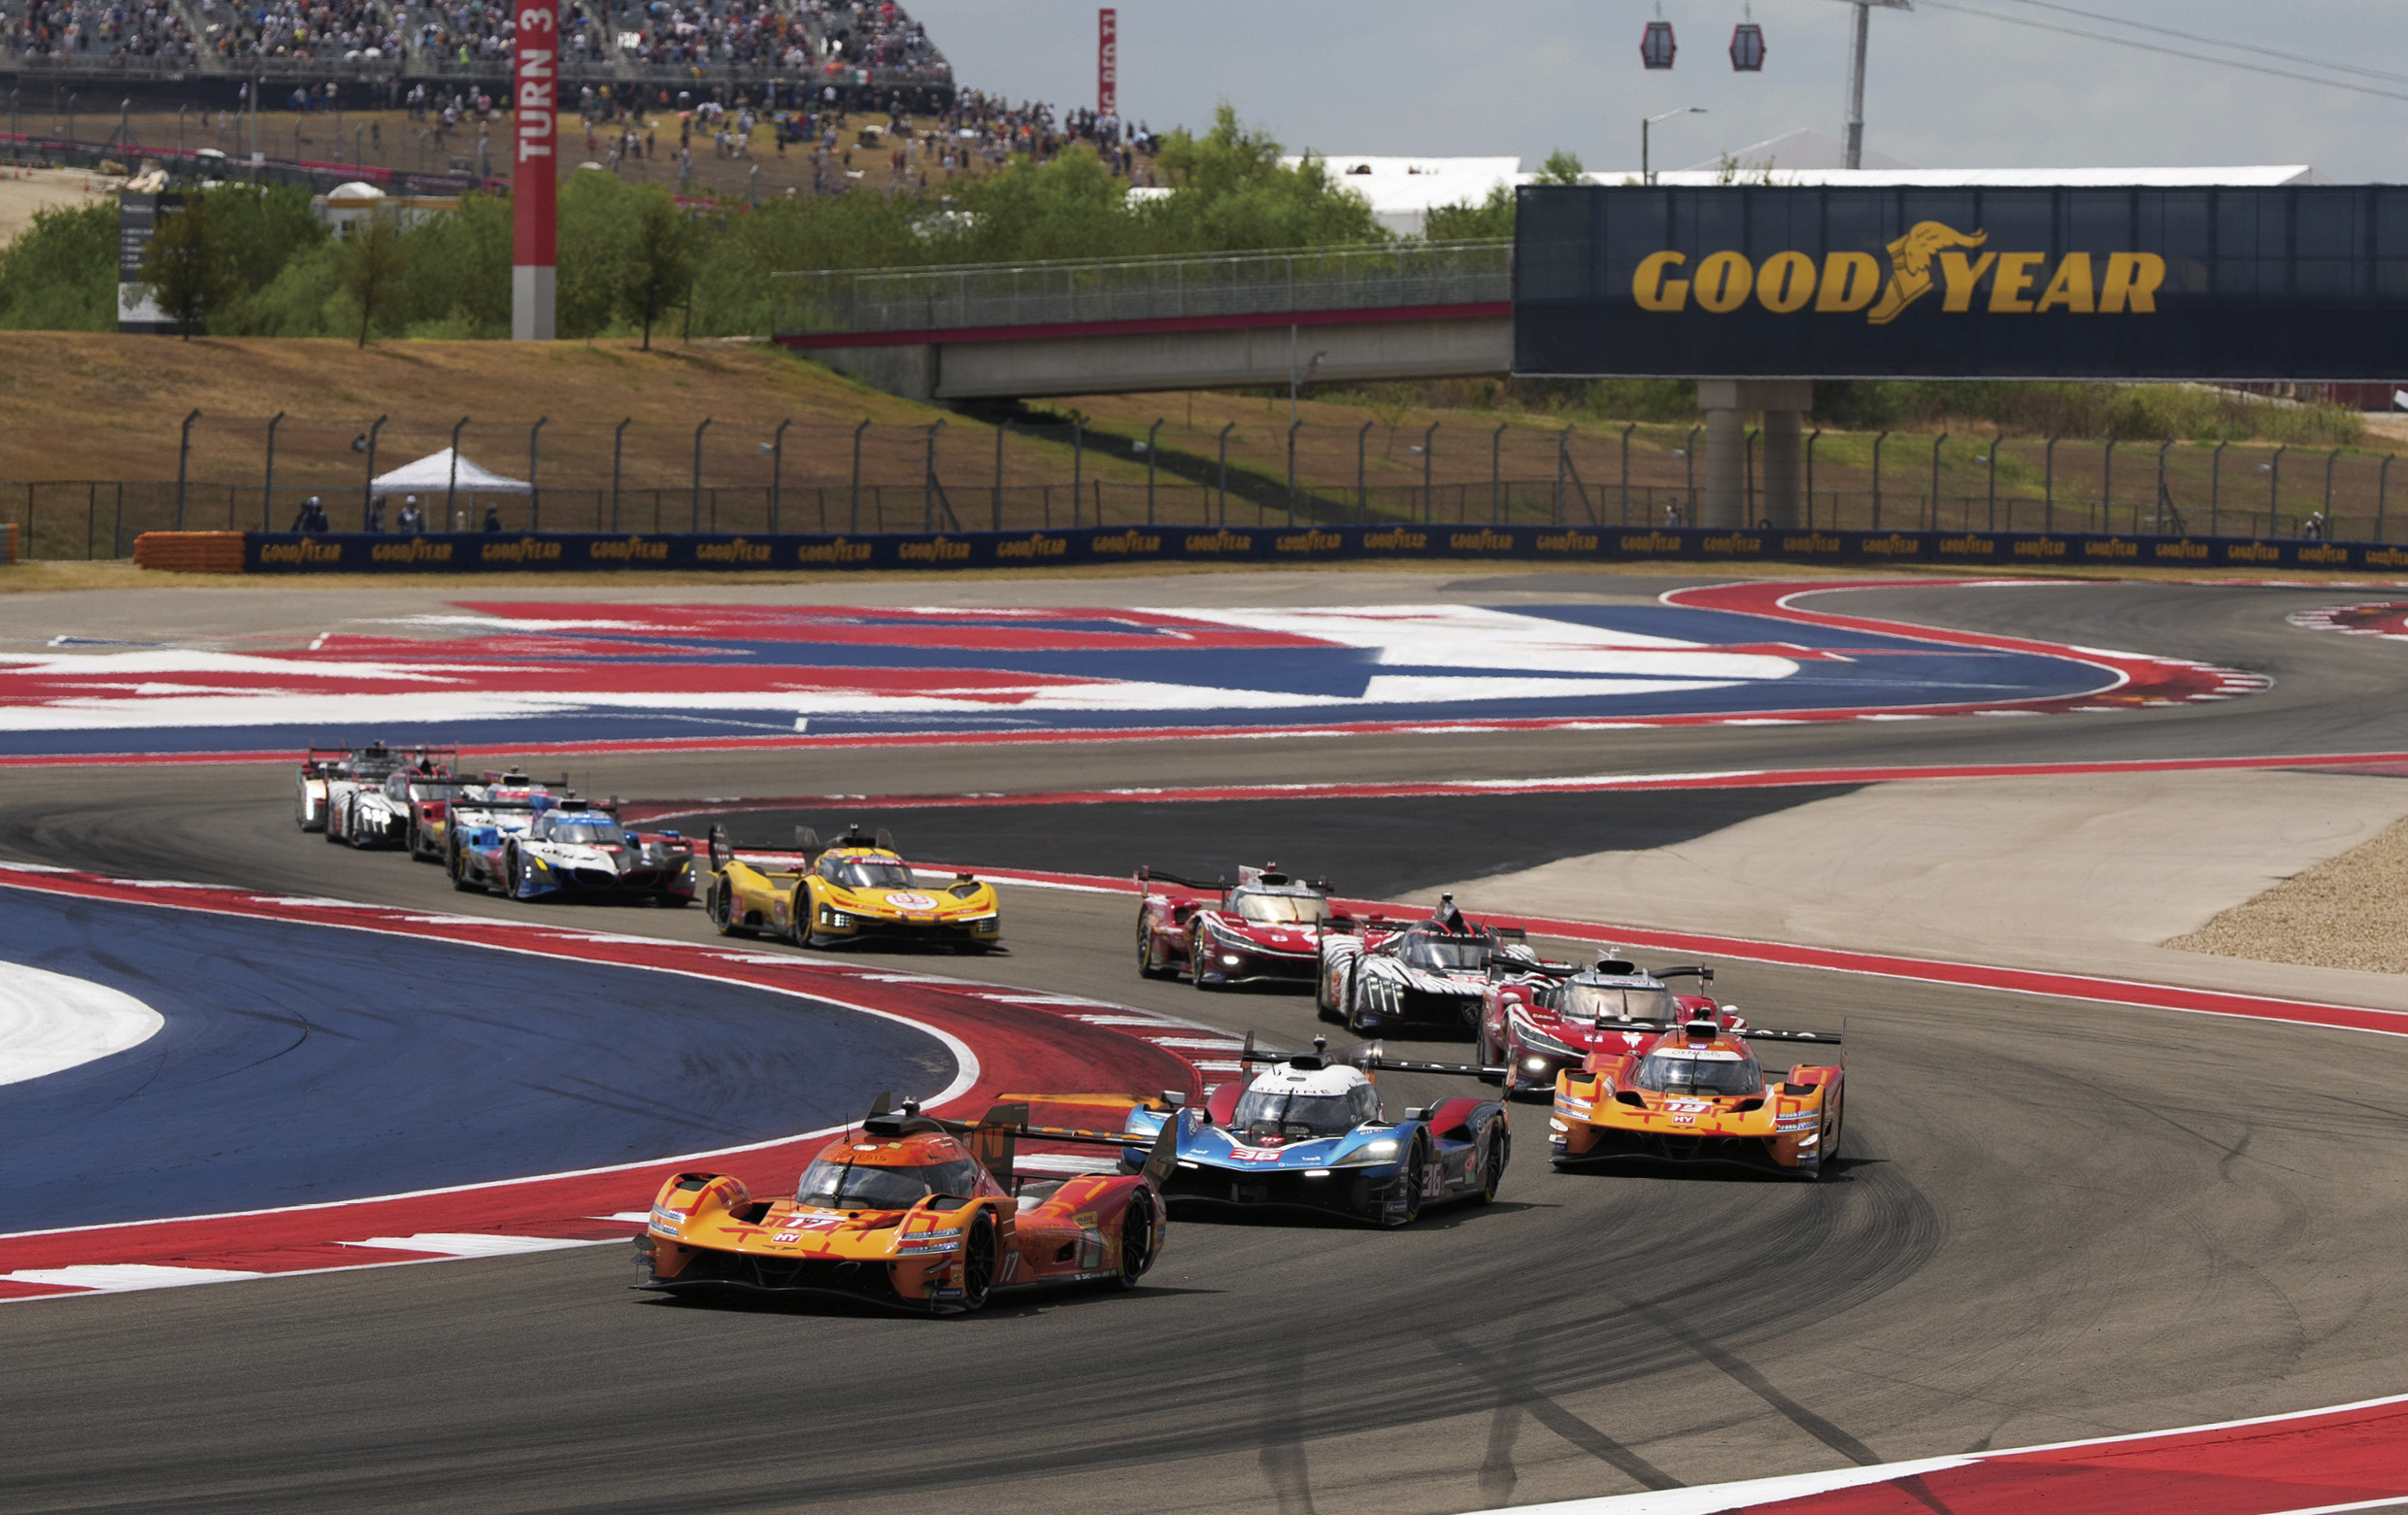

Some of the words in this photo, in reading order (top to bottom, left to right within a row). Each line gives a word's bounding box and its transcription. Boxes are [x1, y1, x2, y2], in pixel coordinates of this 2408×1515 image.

[520, 7, 553, 32] 3
[519, 50, 552, 162] TURN
[1631, 233, 2166, 323] GOODYEAR
[260, 541, 342, 562] GOODYEAR
[372, 541, 452, 561] GOODYEAR
[482, 541, 561, 560] GOODYEAR
[590, 540, 668, 559] GOODYEAR
[696, 542, 771, 560] GOODYEAR
[799, 541, 872, 560] GOODYEAR
[899, 540, 971, 559] GOODYEAR
[997, 537, 1067, 556] GOODYEAR
[1092, 533, 1161, 552] GOODYEAR
[1186, 533, 1252, 552] GOODYEAR
[1276, 533, 1342, 551] GOODYEAR
[1674, 1115, 1693, 1124] HY
[1231, 1147, 1283, 1162] 36
[1422, 1164, 1443, 1197] 36
[785, 1218, 836, 1229] 17
[775, 1233, 800, 1243] HY
[999, 1251, 1020, 1283] 17
